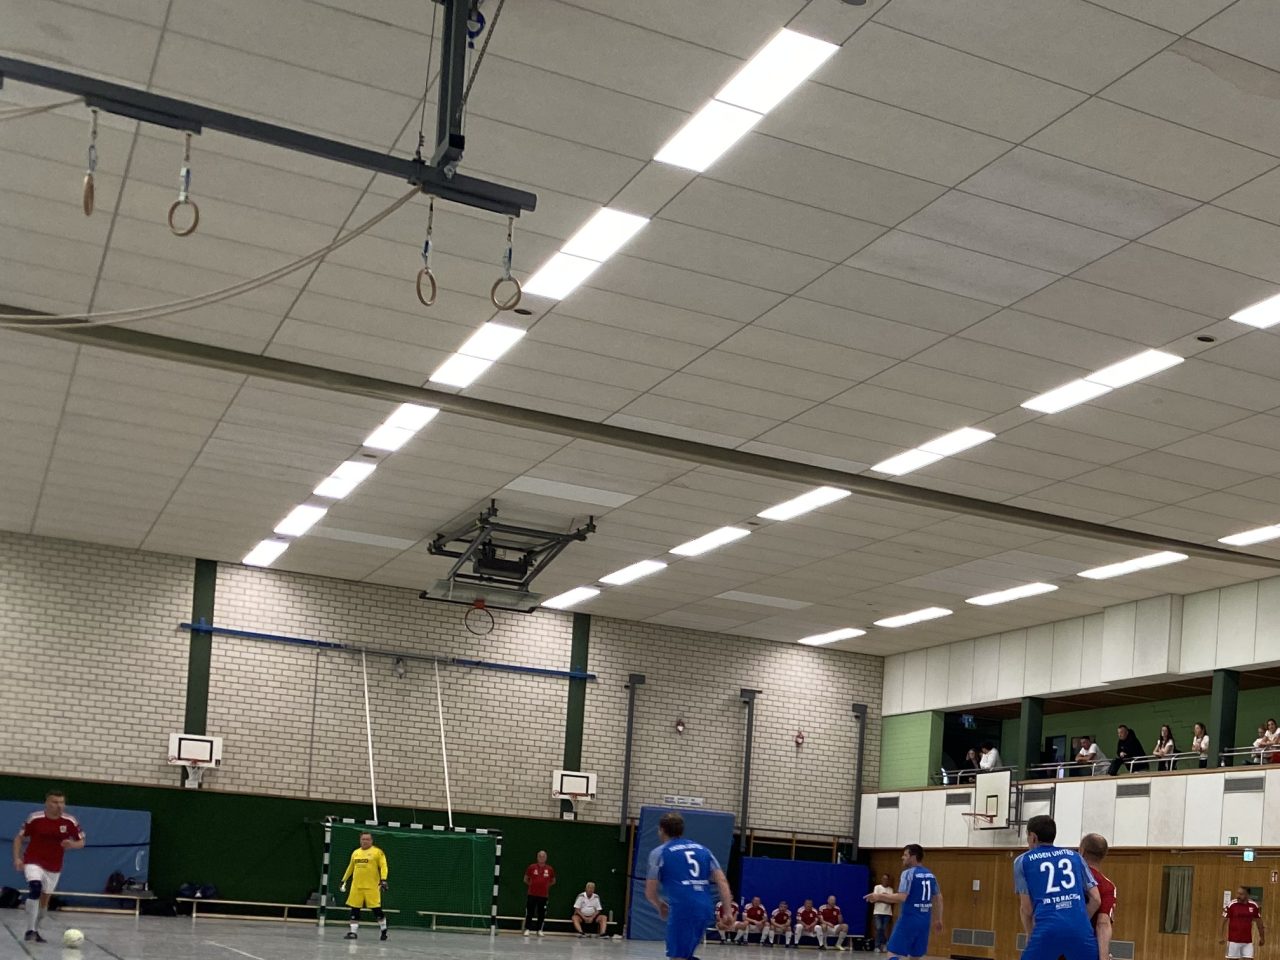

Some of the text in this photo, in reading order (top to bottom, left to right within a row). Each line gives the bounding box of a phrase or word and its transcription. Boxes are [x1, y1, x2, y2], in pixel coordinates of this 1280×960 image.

[684, 850, 700, 877] 5
[1040, 858, 1076, 894] 23
[921, 880, 931, 901] 11
